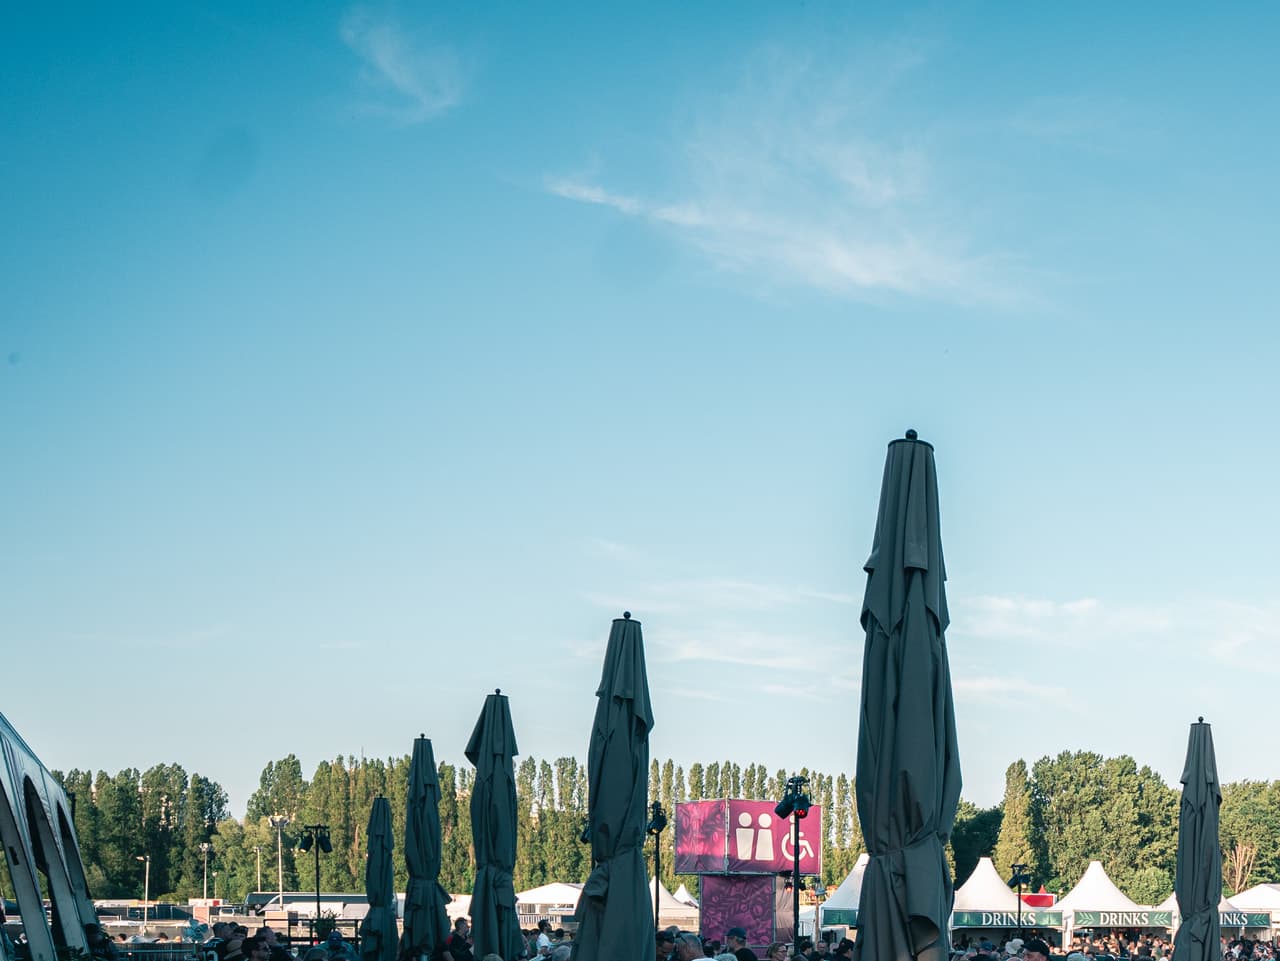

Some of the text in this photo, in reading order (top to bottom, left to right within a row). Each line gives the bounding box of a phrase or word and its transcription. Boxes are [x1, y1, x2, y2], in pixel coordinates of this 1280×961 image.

[981, 912, 1037, 926] DRINKS
[1100, 912, 1149, 926] DRINKS
[1220, 912, 1248, 926] INKS
